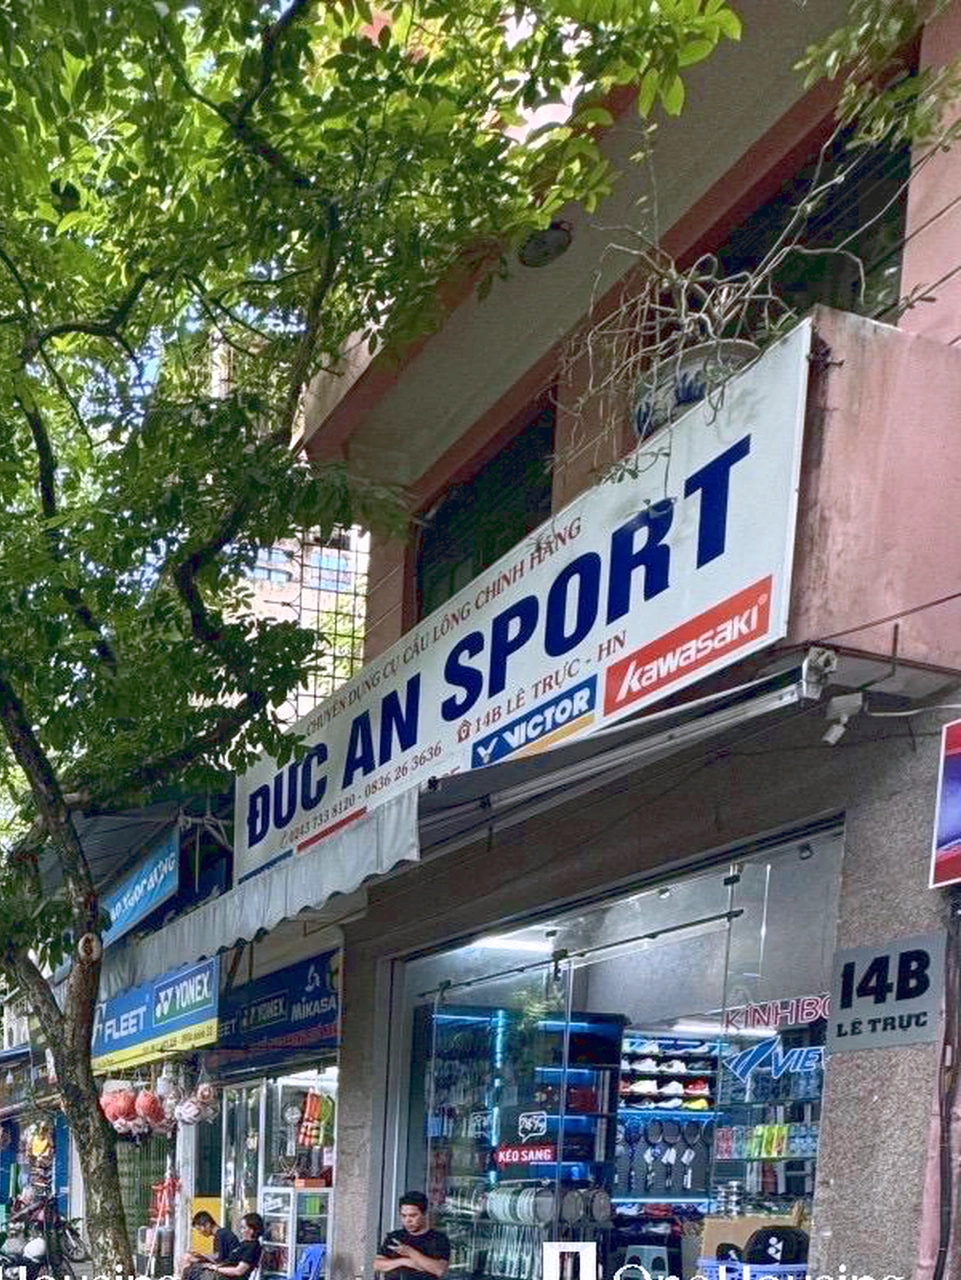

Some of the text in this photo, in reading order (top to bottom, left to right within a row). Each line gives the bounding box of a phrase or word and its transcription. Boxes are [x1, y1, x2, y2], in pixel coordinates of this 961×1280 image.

[474, 559, 525, 610] CHÍNH
[342, 673, 421, 790] AN
[441, 433, 751, 721] SPORT
[475, 704, 502, 733] 14B
[506, 688, 526, 715] LÊ
[597, 629, 627, 662] HN
[502, 687, 591, 748] VICTOR
[394, 761, 408, 782] 26
[411, 740, 442, 771] 3636
[175, 970, 210, 1010] YONEX
[840, 949, 931, 1010] 14B
[104, 1005, 146, 1043] FLEET
[836, 1017, 863, 1038] LÊ
[521, 1149, 552, 1161] SANG
